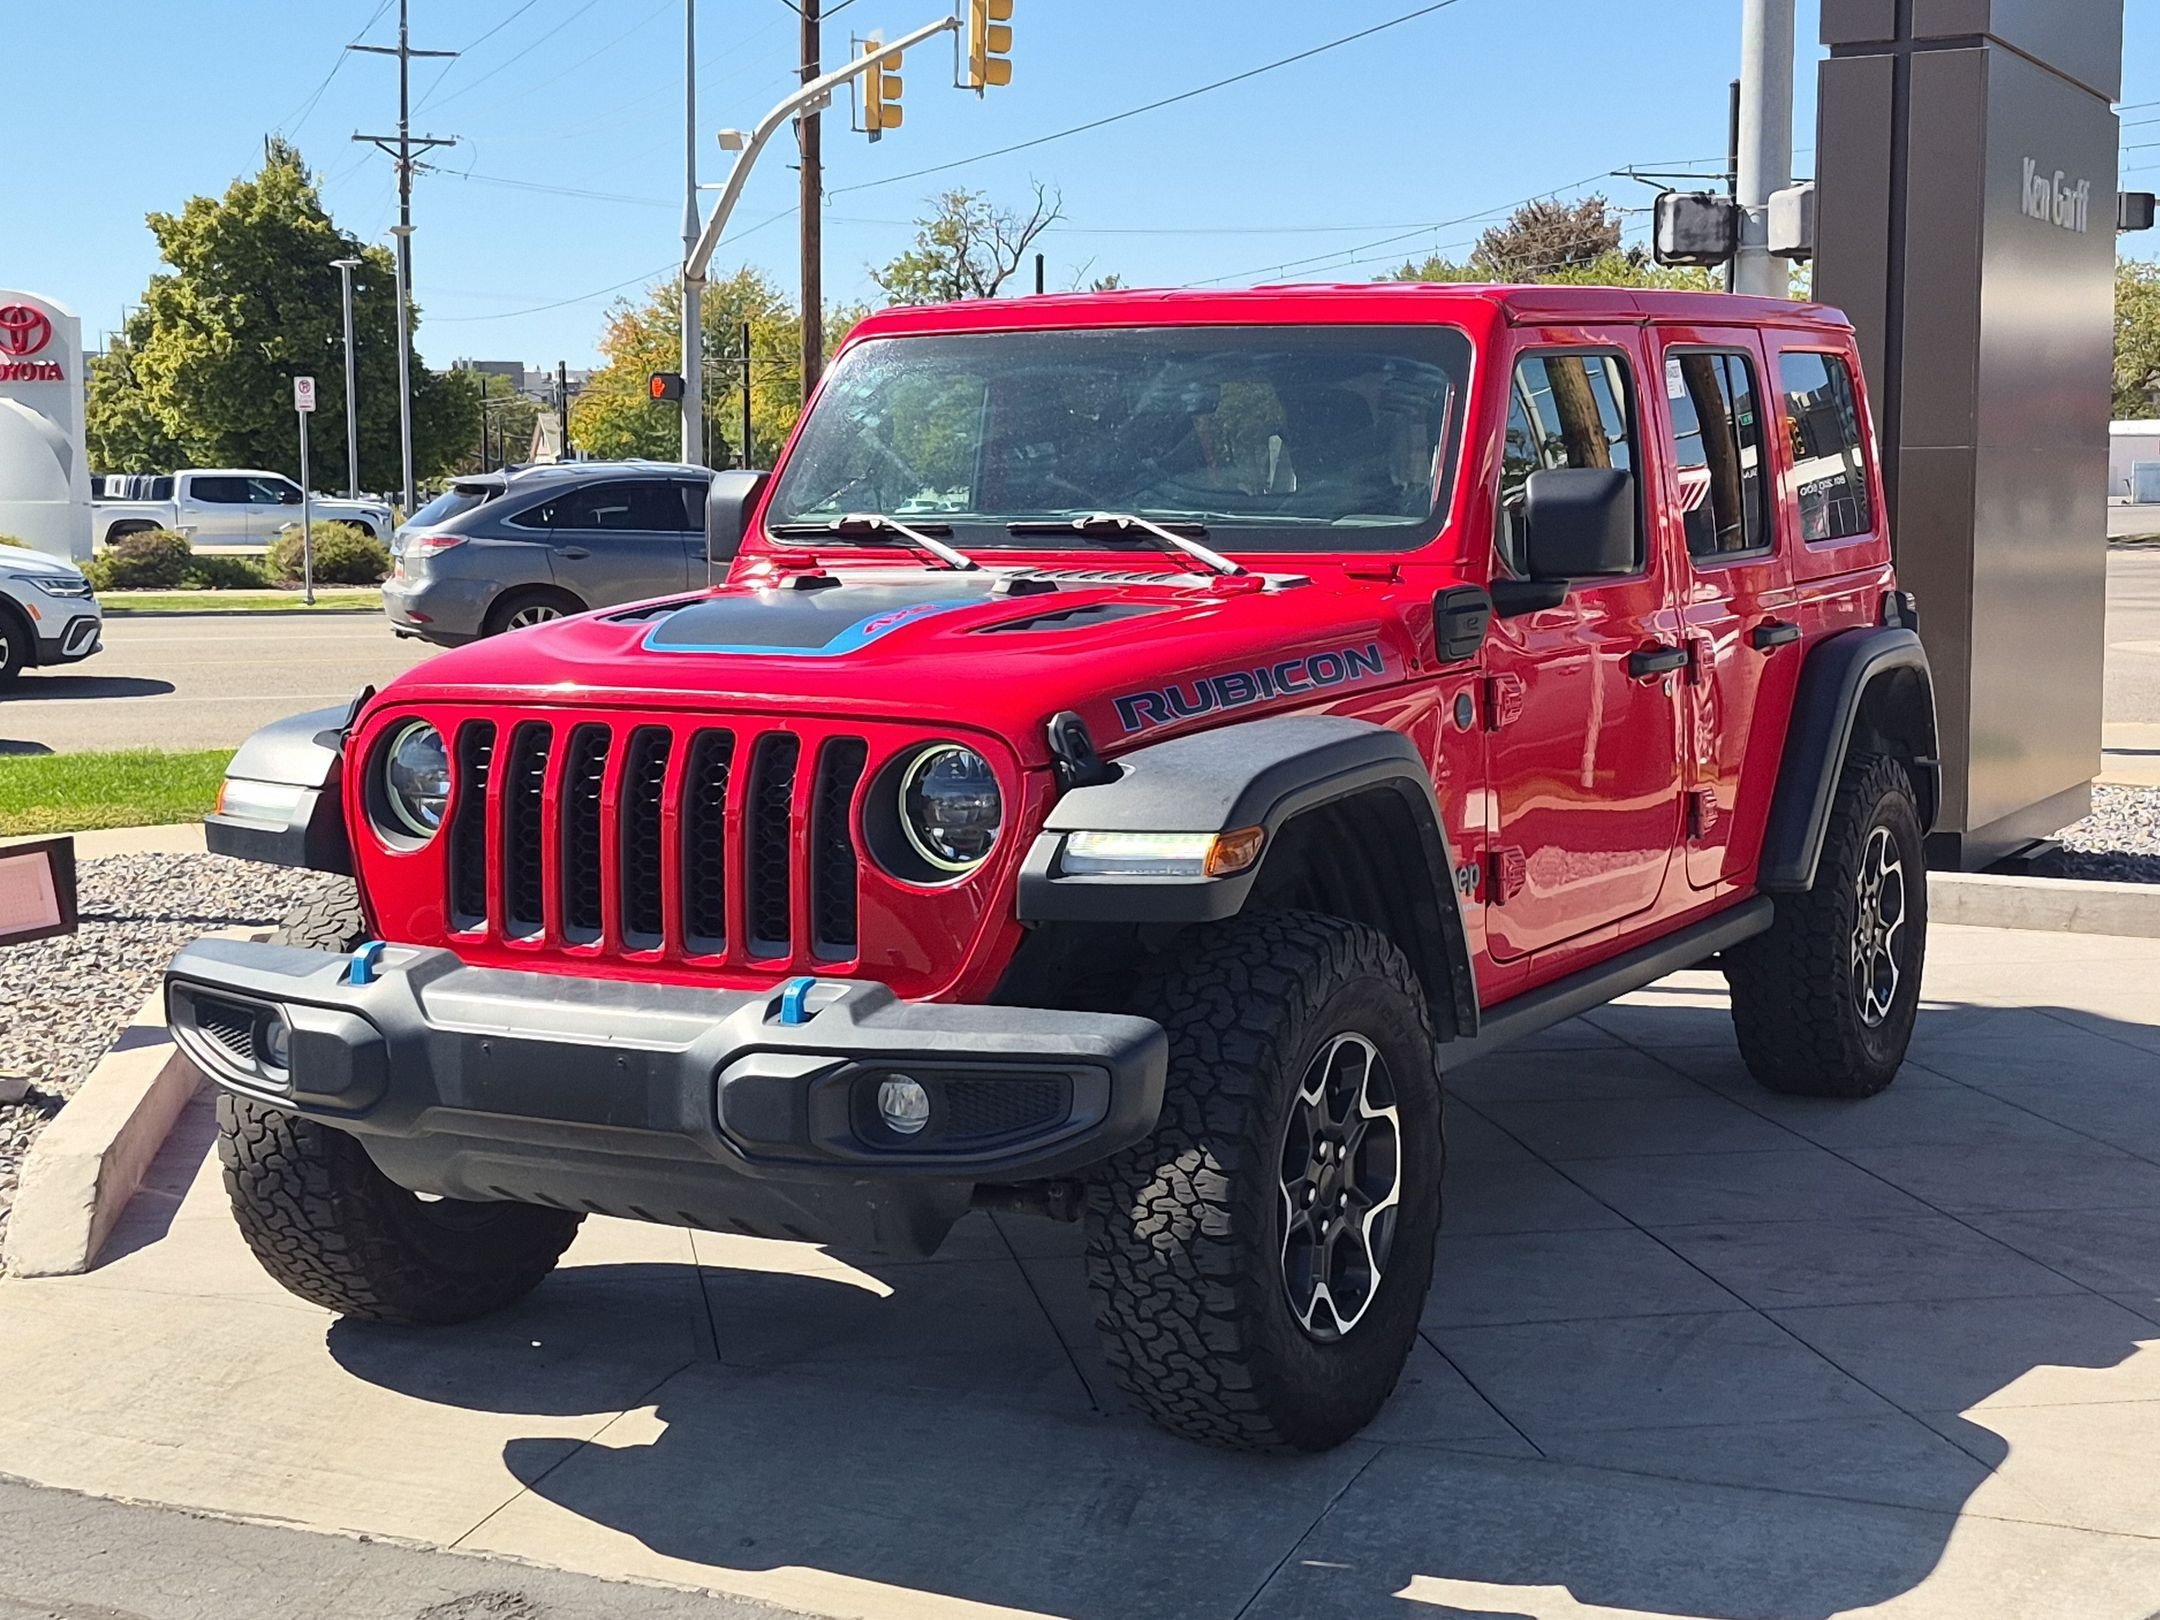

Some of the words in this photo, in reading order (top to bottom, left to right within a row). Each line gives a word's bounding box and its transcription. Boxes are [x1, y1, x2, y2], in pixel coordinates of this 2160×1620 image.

[2022, 156, 2050, 221] Ken
[0, 361, 65, 381] OYOTA
[1112, 642, 1386, 732] RUBICON
[1457, 863, 1480, 896] ep
